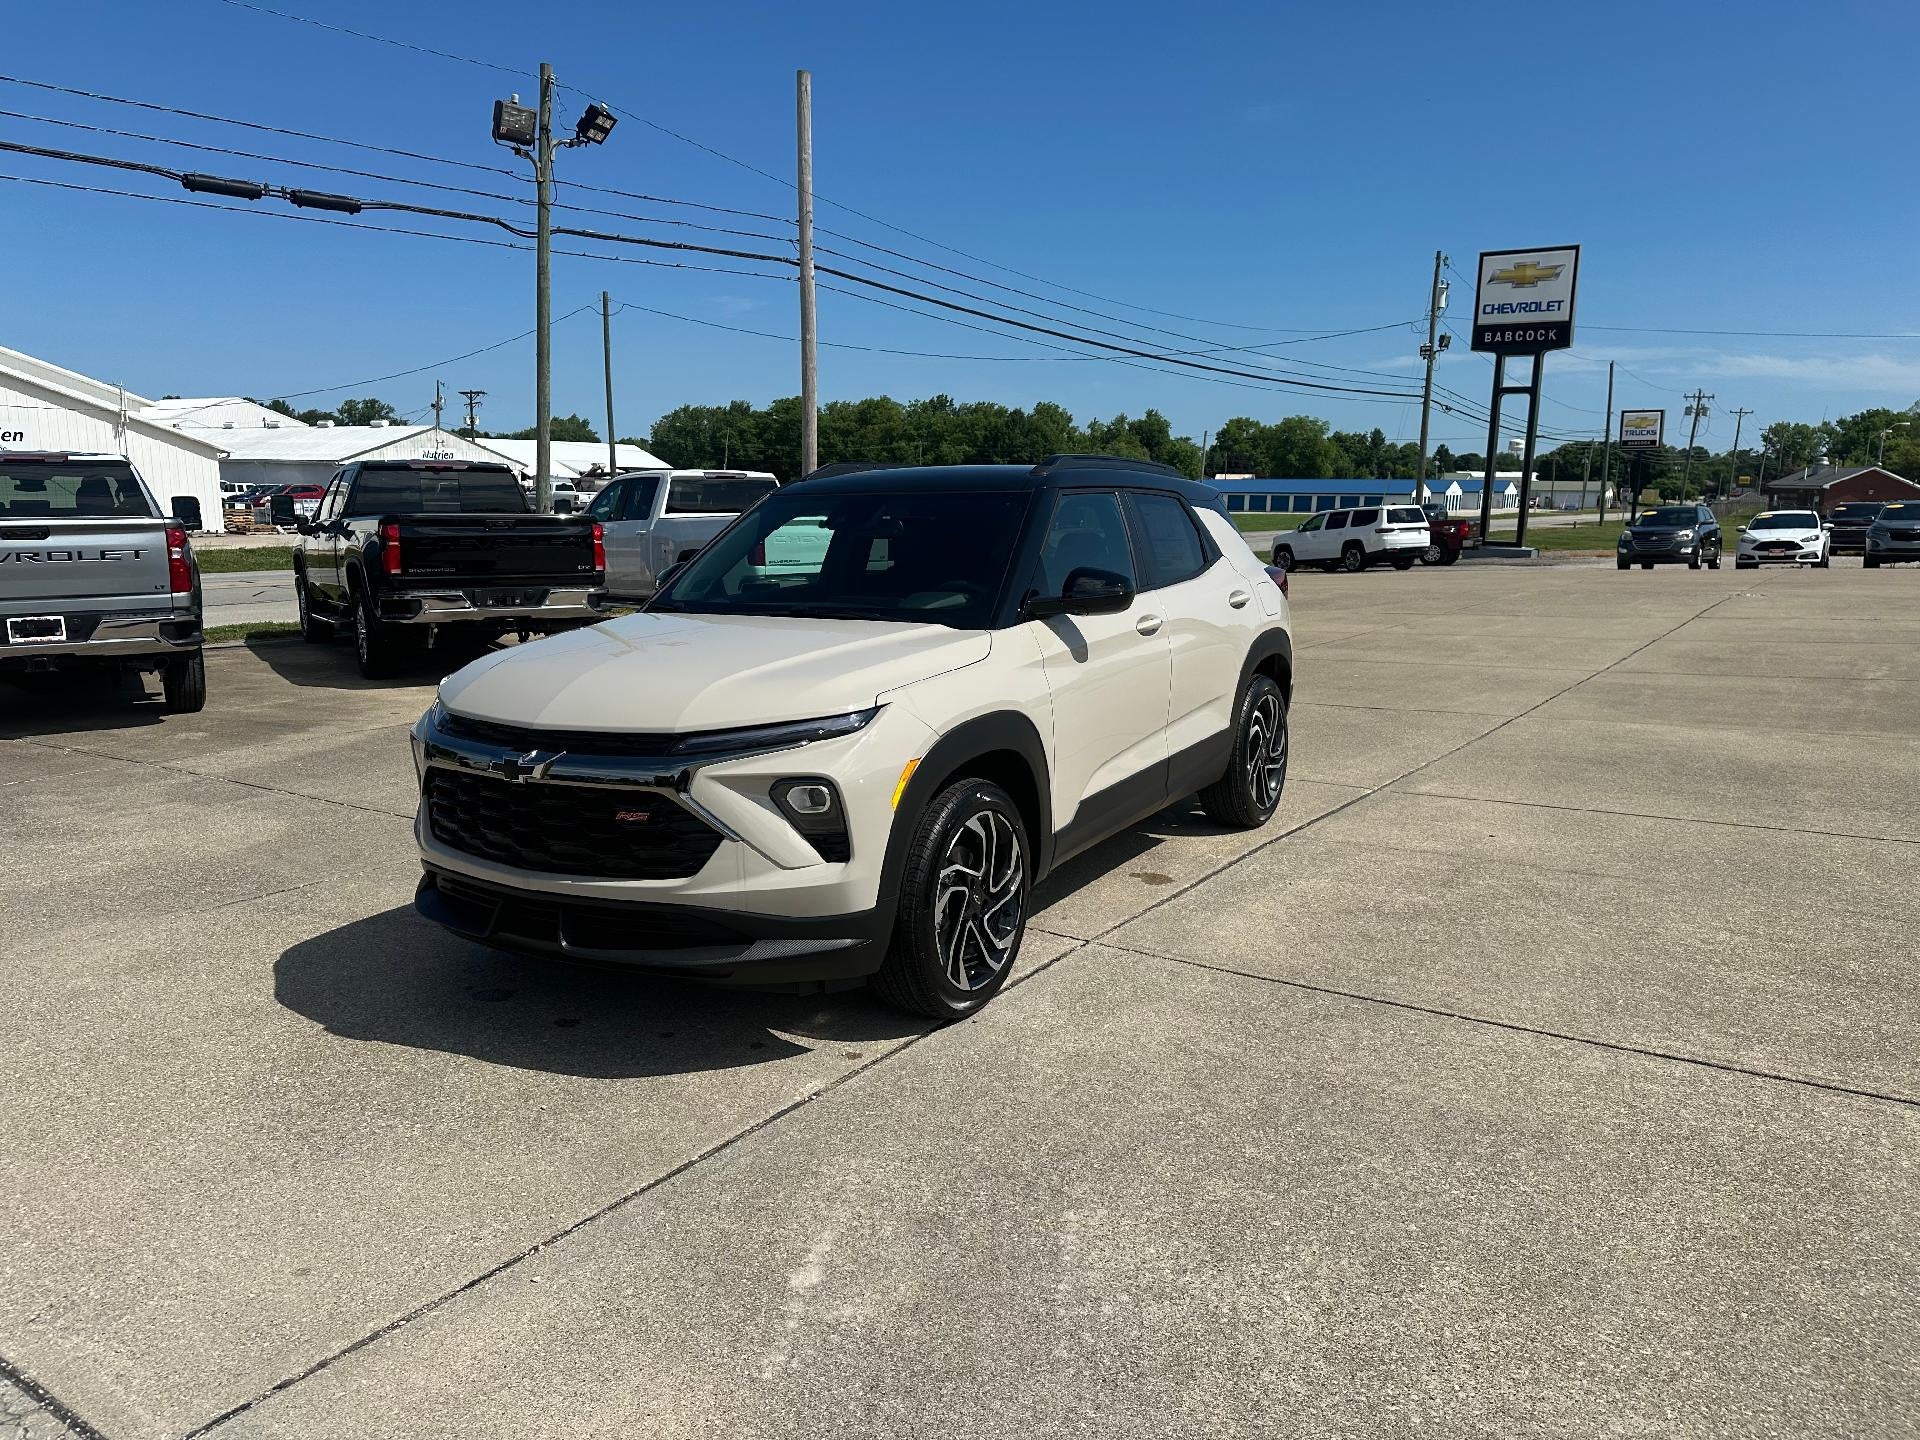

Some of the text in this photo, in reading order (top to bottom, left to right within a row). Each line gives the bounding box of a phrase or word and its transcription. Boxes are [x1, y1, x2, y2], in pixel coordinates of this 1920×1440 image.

[1483, 300, 1564, 315] CHEVROLET
[1485, 330, 1557, 342] BABCOCK
[0, 427, 23, 441] en
[422, 450, 454, 460] Nutrien
